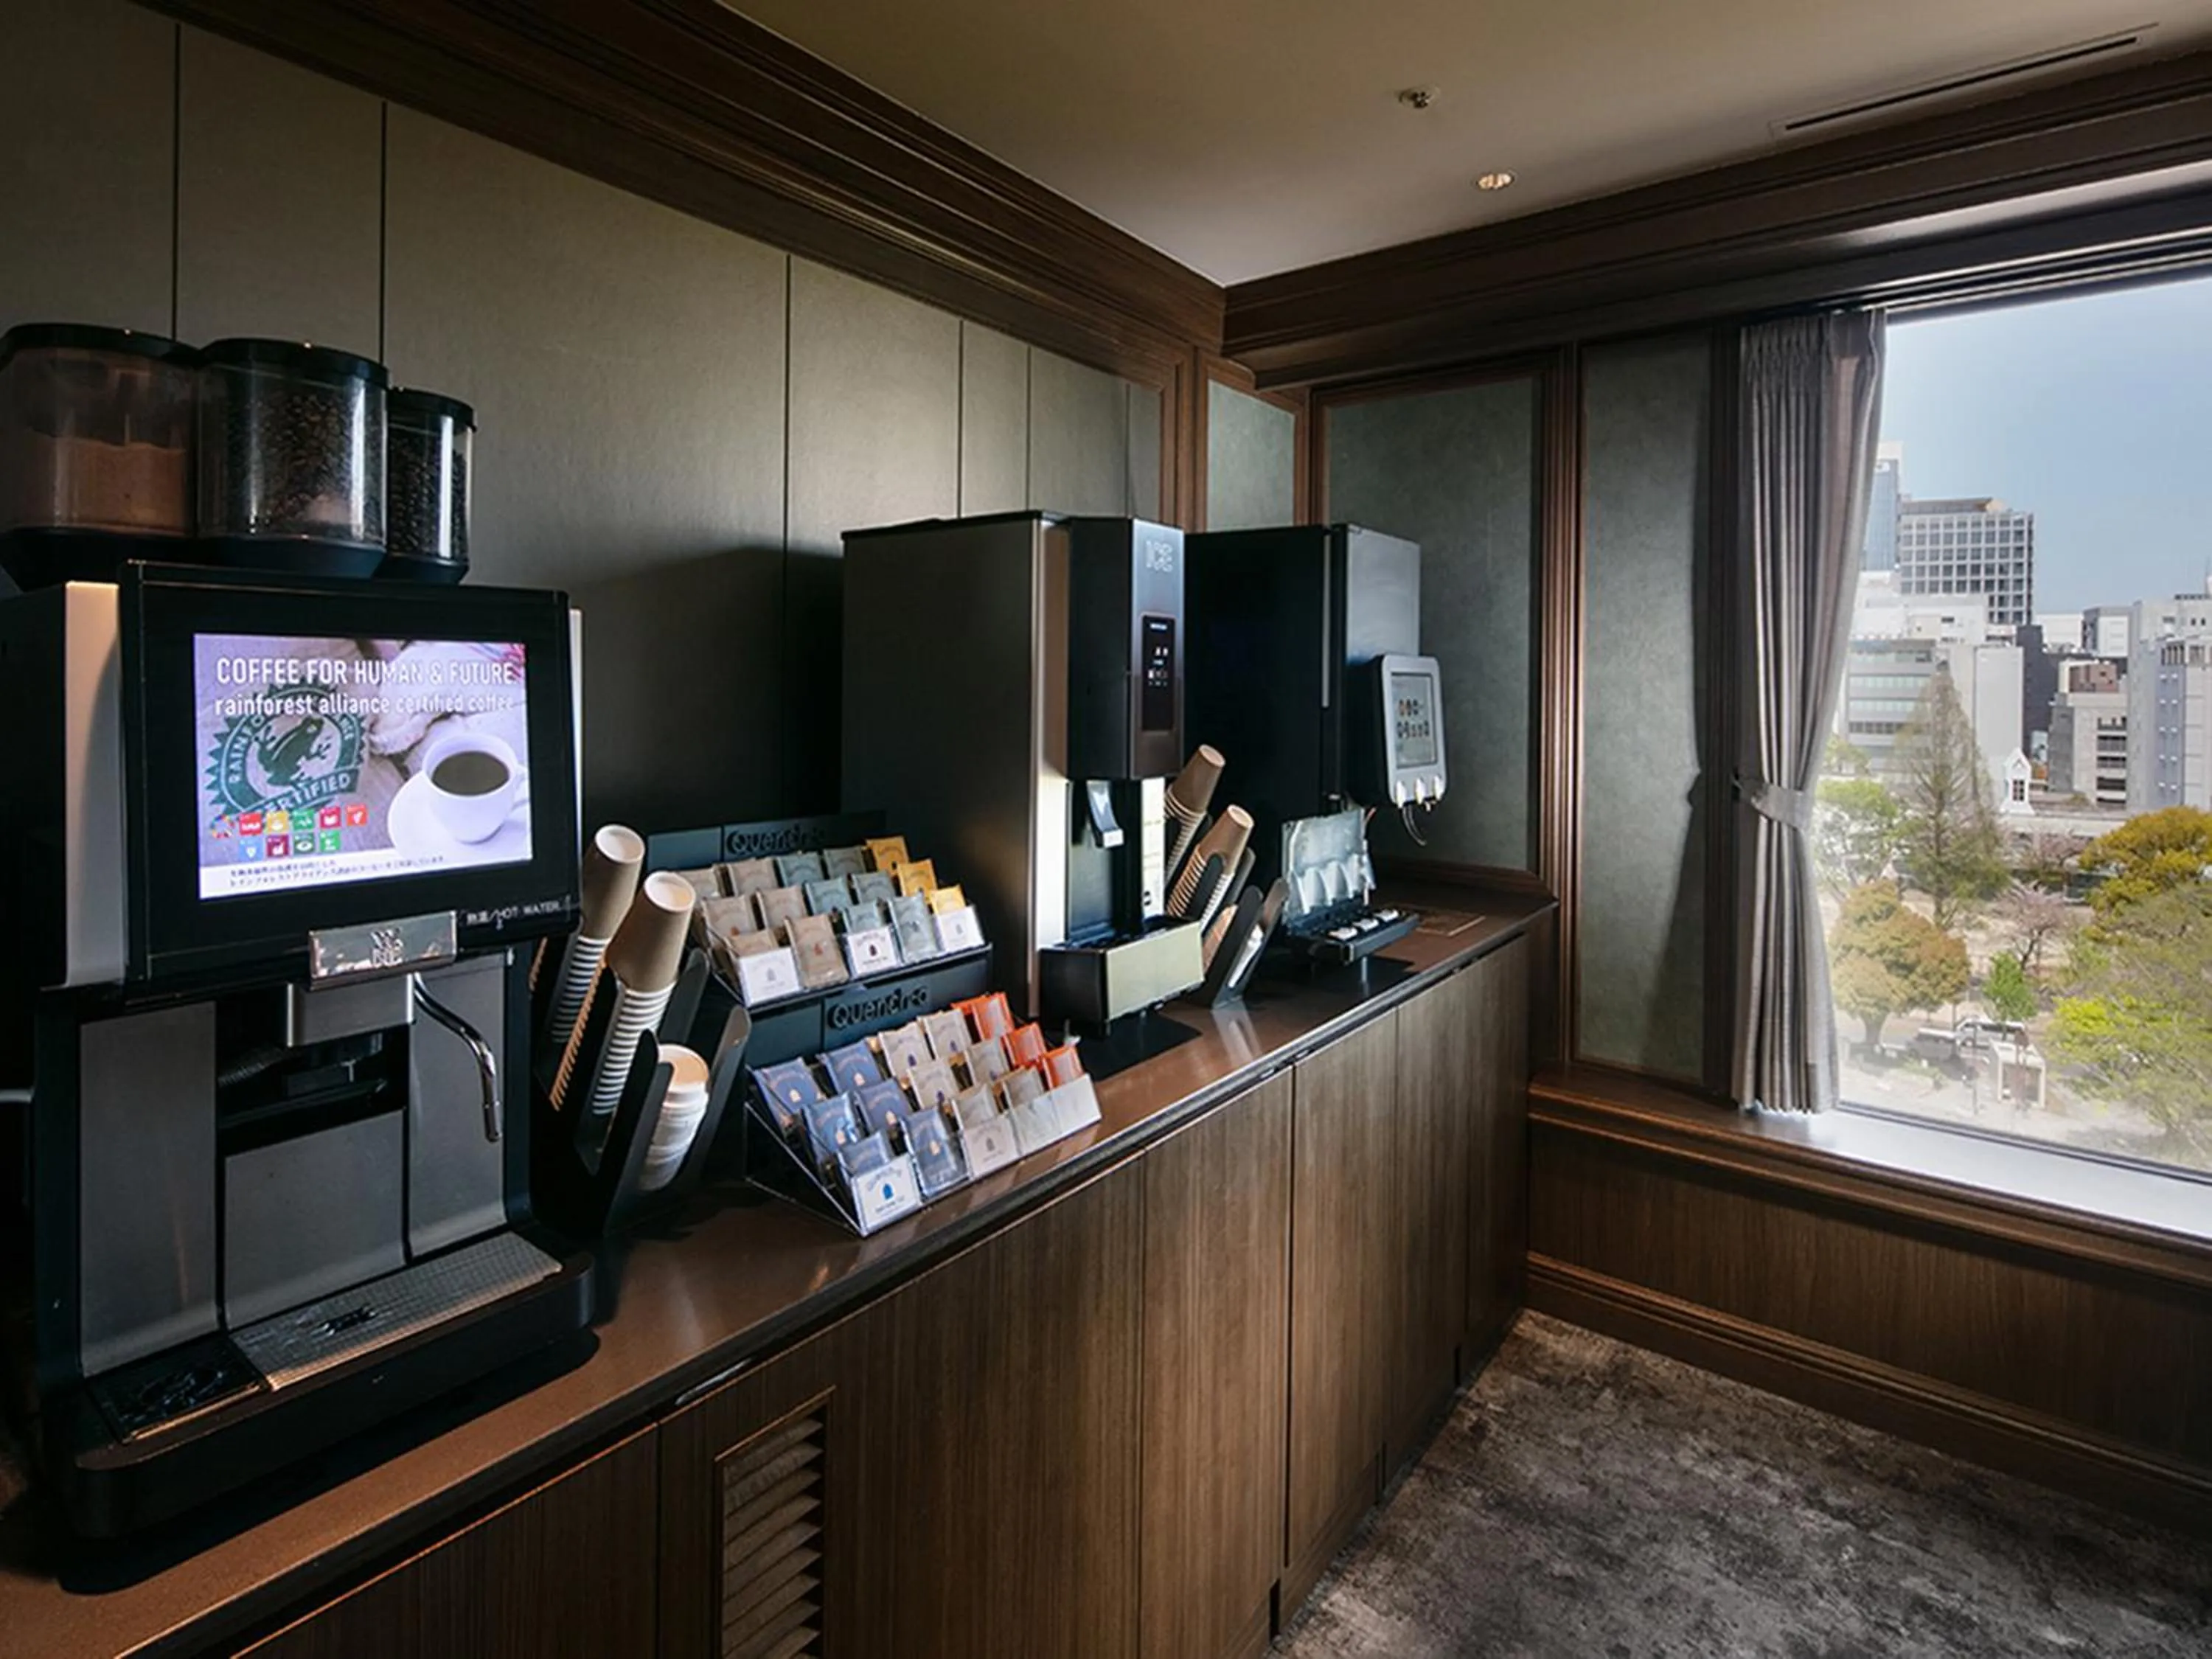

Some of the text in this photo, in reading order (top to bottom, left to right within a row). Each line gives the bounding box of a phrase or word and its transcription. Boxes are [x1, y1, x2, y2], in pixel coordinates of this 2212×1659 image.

[217, 658, 300, 684] COFFEE
[307, 658, 348, 684] FOR
[355, 660, 423, 684] HUMAN
[430, 661, 442, 684] &
[214, 693, 513, 715] rainforest alliance certified coffee
[264, 773, 352, 812] ERTIFIED
